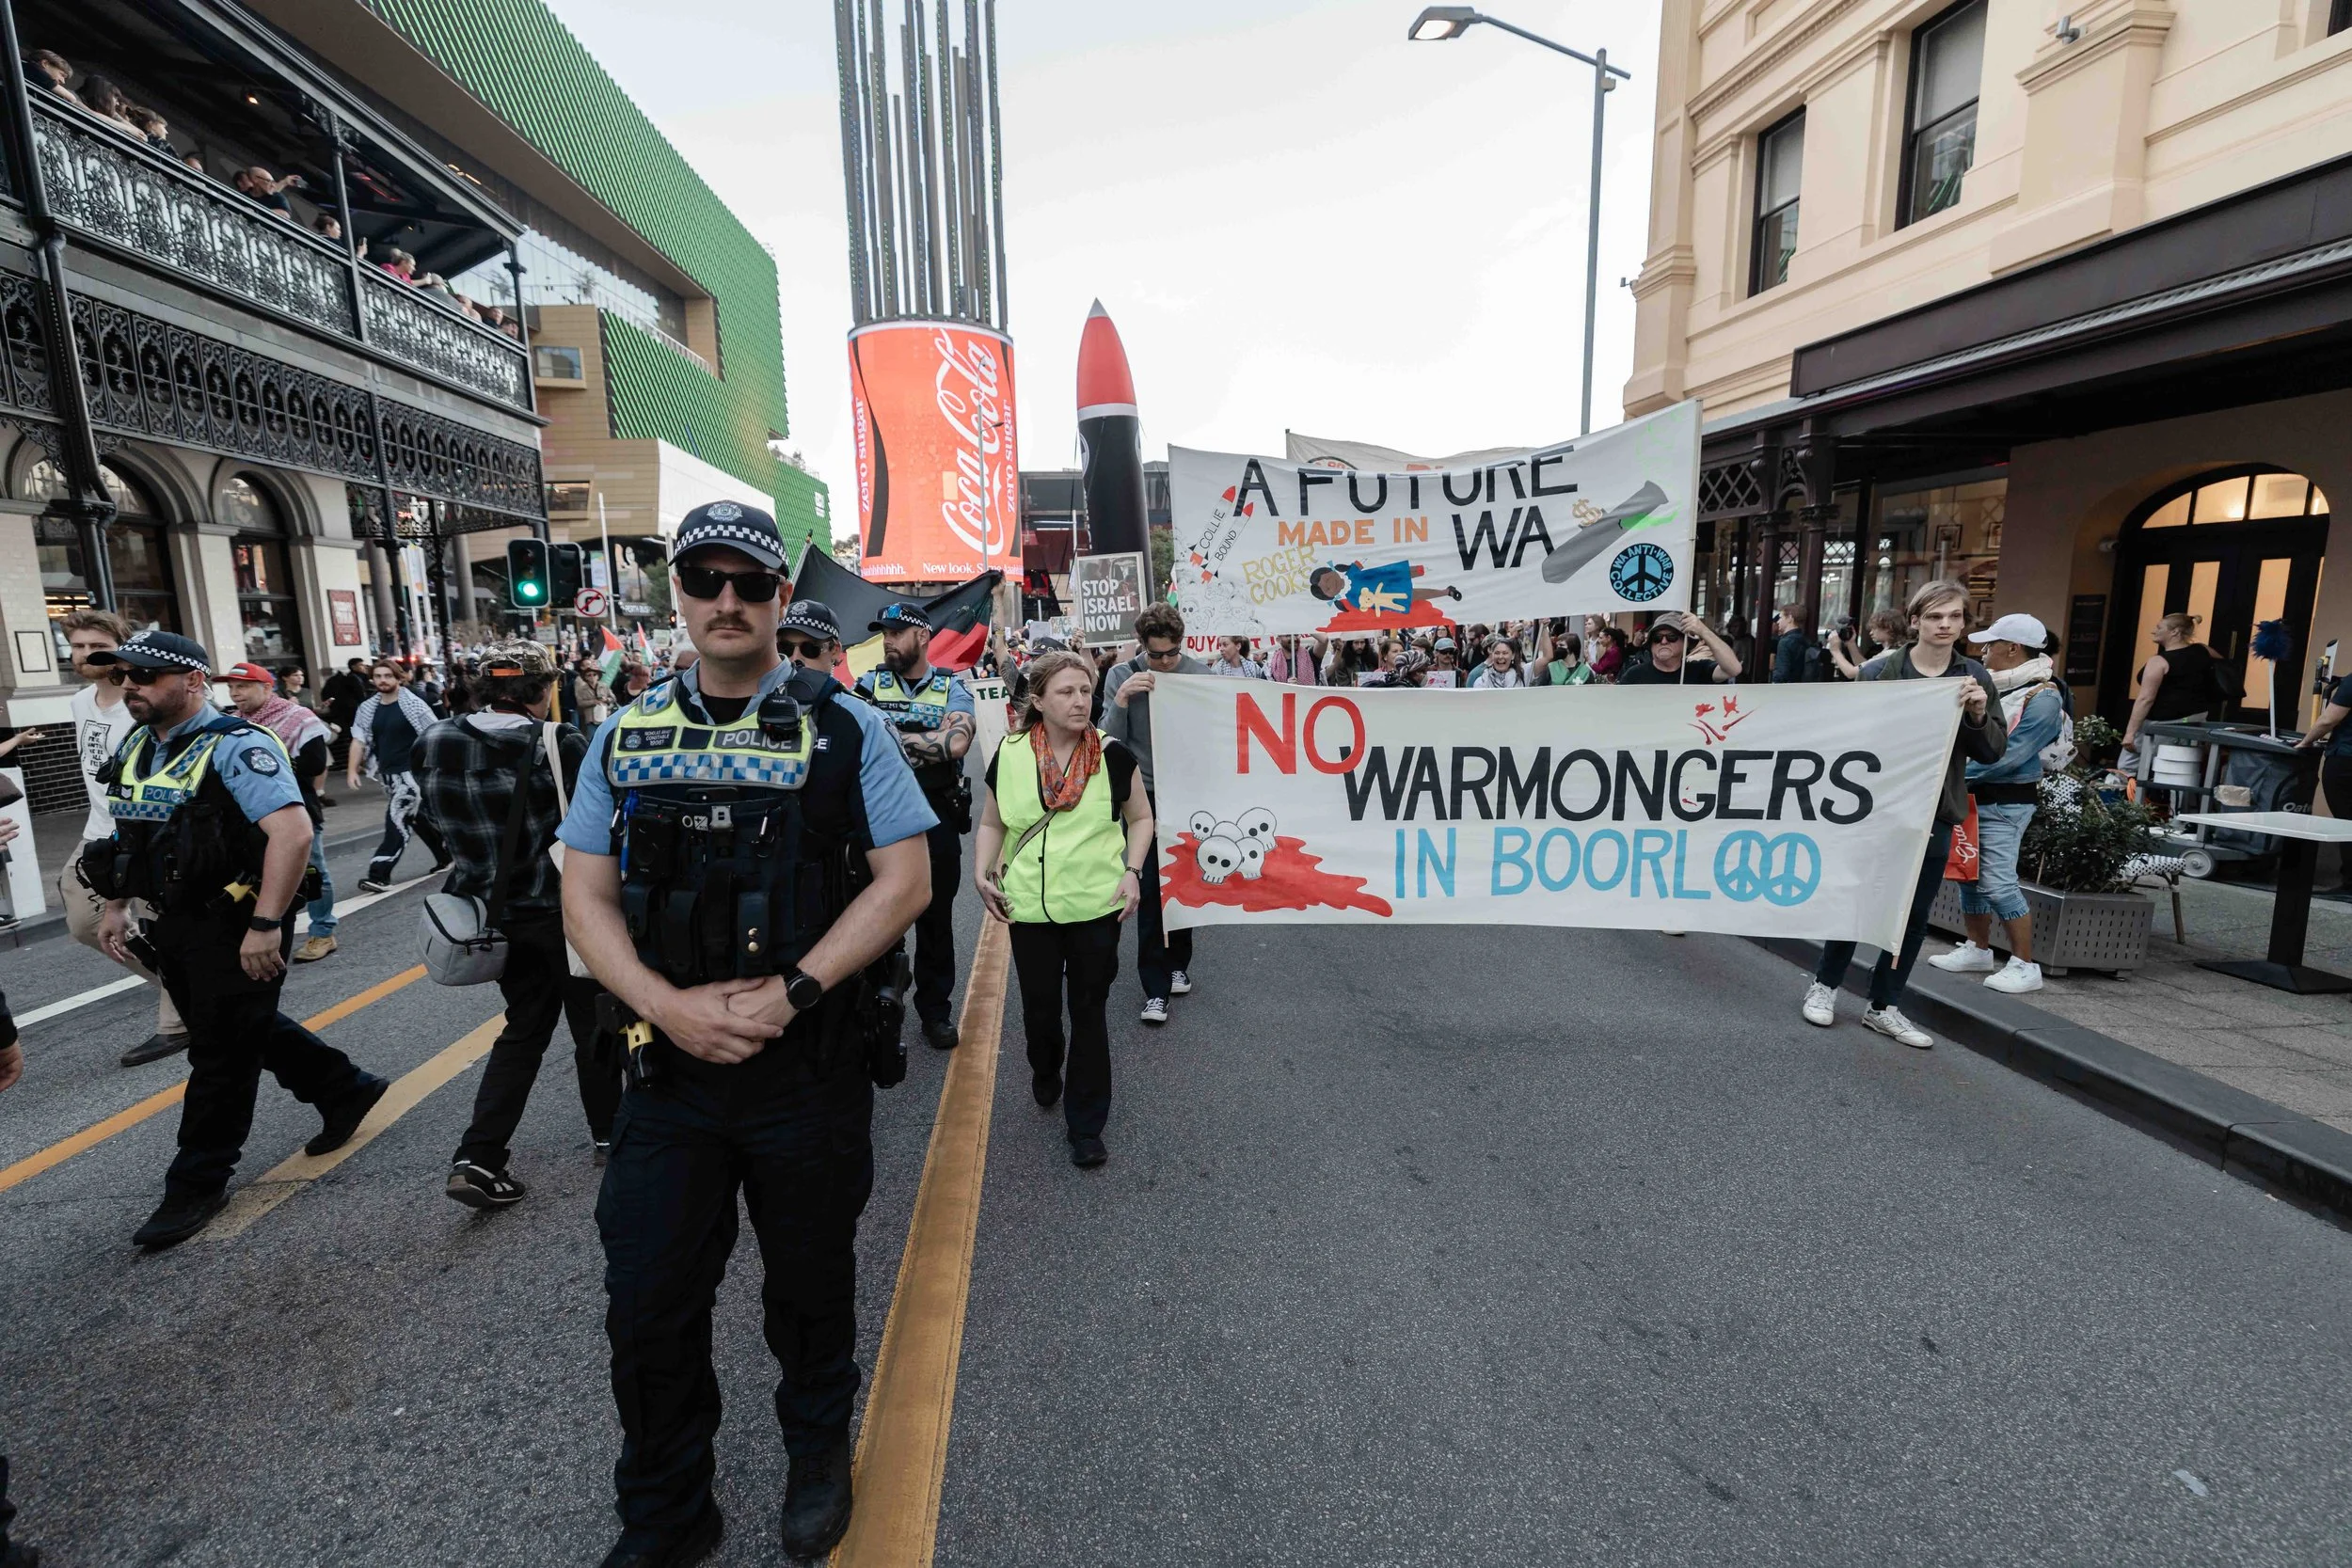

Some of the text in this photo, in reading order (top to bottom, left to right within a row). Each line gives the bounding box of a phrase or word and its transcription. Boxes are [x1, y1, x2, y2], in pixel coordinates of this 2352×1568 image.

[1003, 400, 1015, 514] zero sugar
[859, 464, 869, 512] zero
[1232, 445, 1578, 516] A FUTURE
[1199, 508, 1226, 549] COLLIE
[1214, 530, 1237, 561] BOUND
[1278, 516, 1428, 546] MADE IN
[1452, 505, 1554, 571] WA
[923, 563, 947, 573] New
[948, 562, 975, 574] look.
[1242, 544, 1317, 585] ROGER
[1613, 554, 1629, 569] WA
[1082, 579, 1119, 596] STOP
[1084, 596, 1135, 614] ISRAEL
[1610, 570, 1673, 602] COLLECTIVE
[1085, 614, 1120, 632] NOW
[1236, 692, 1365, 775] NO
[1339, 746, 1882, 824] WARMONGERS
[1395, 828, 1456, 898] IN
